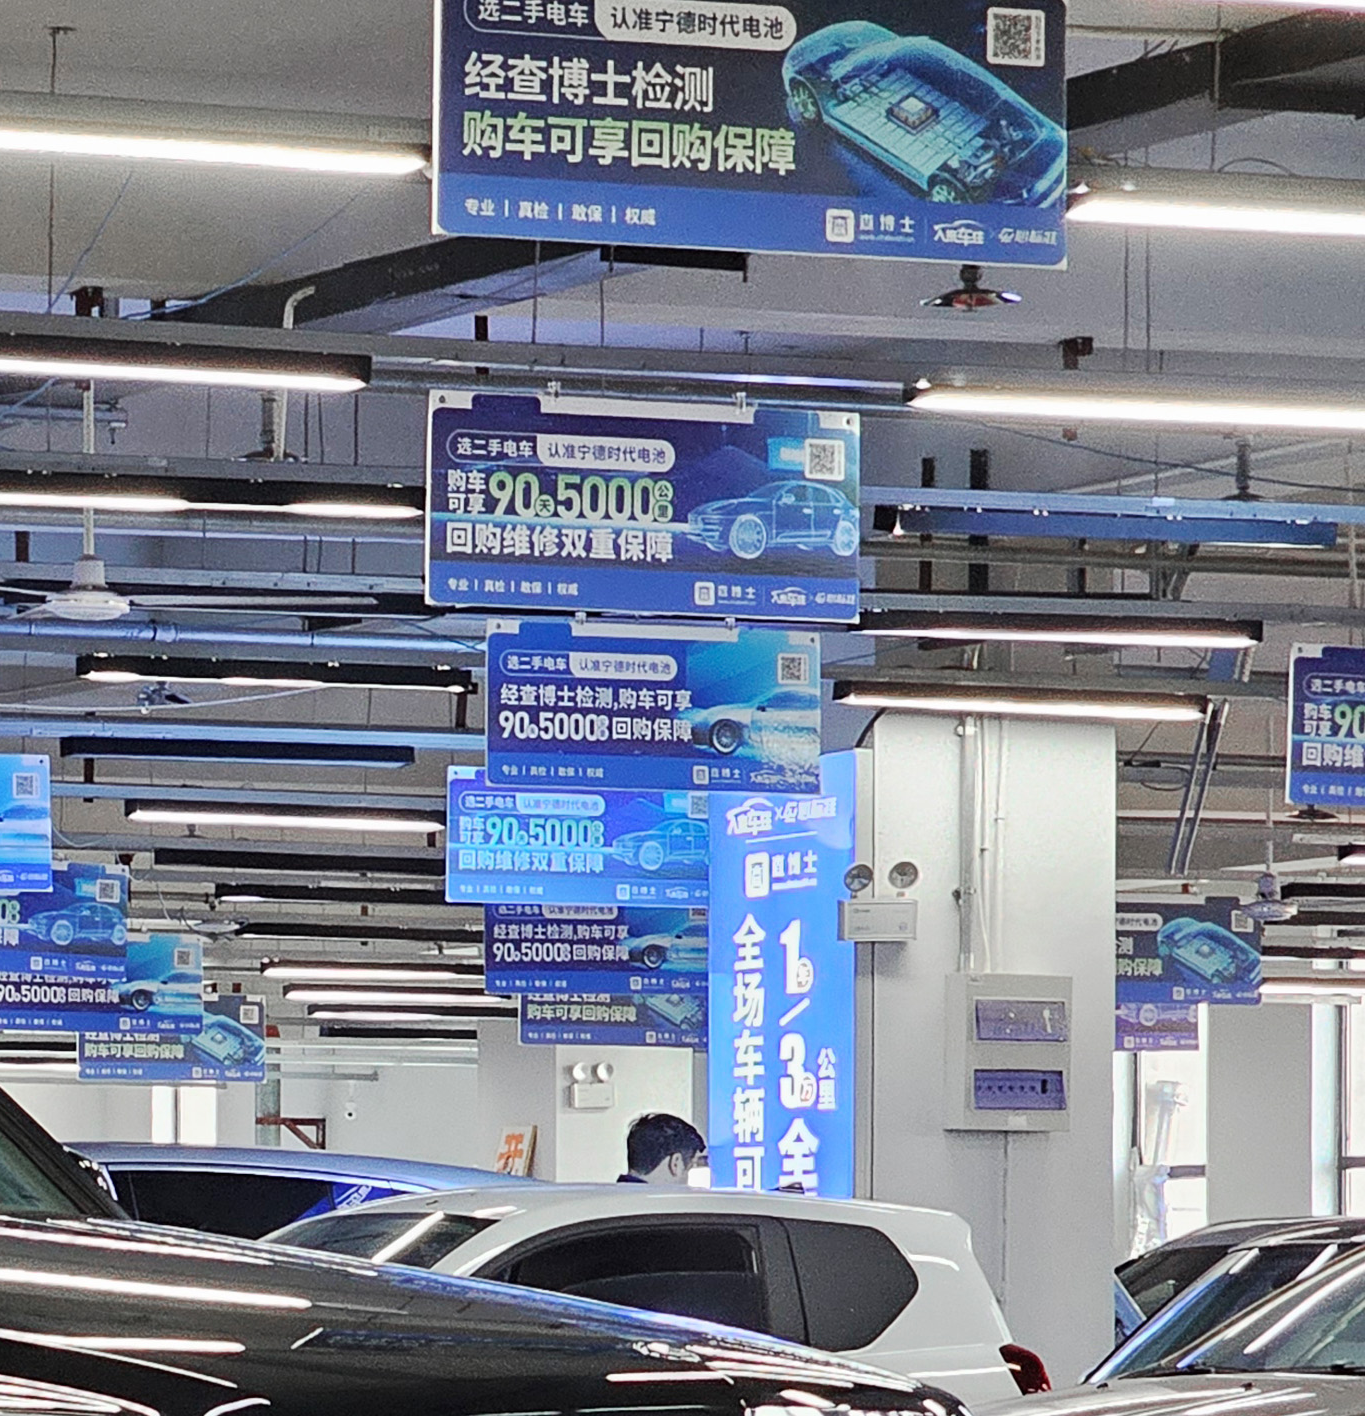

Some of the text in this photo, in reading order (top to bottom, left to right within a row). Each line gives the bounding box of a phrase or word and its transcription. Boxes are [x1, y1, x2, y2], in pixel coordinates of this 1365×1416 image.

[477, 0, 784, 40] 选二手电车 认准宁德时代电池
[464, 51, 714, 113] 经查博士检测
[462, 110, 796, 175] 购车可享回购保障
[464, 198, 495, 217] 专业
[456, 437, 667, 465] 选二手电车 认准宁德时代电池
[447, 469, 487, 494] 购车
[447, 492, 486, 516] 可享
[445, 522, 674, 564] 回购维修双重保障
[506, 654, 567, 672] 选二手电车
[500, 683, 693, 712] 经查博士检测,购车可享
[611, 717, 693, 743] 回购保障
[458, 851, 605, 875] 回购维修双重保障
